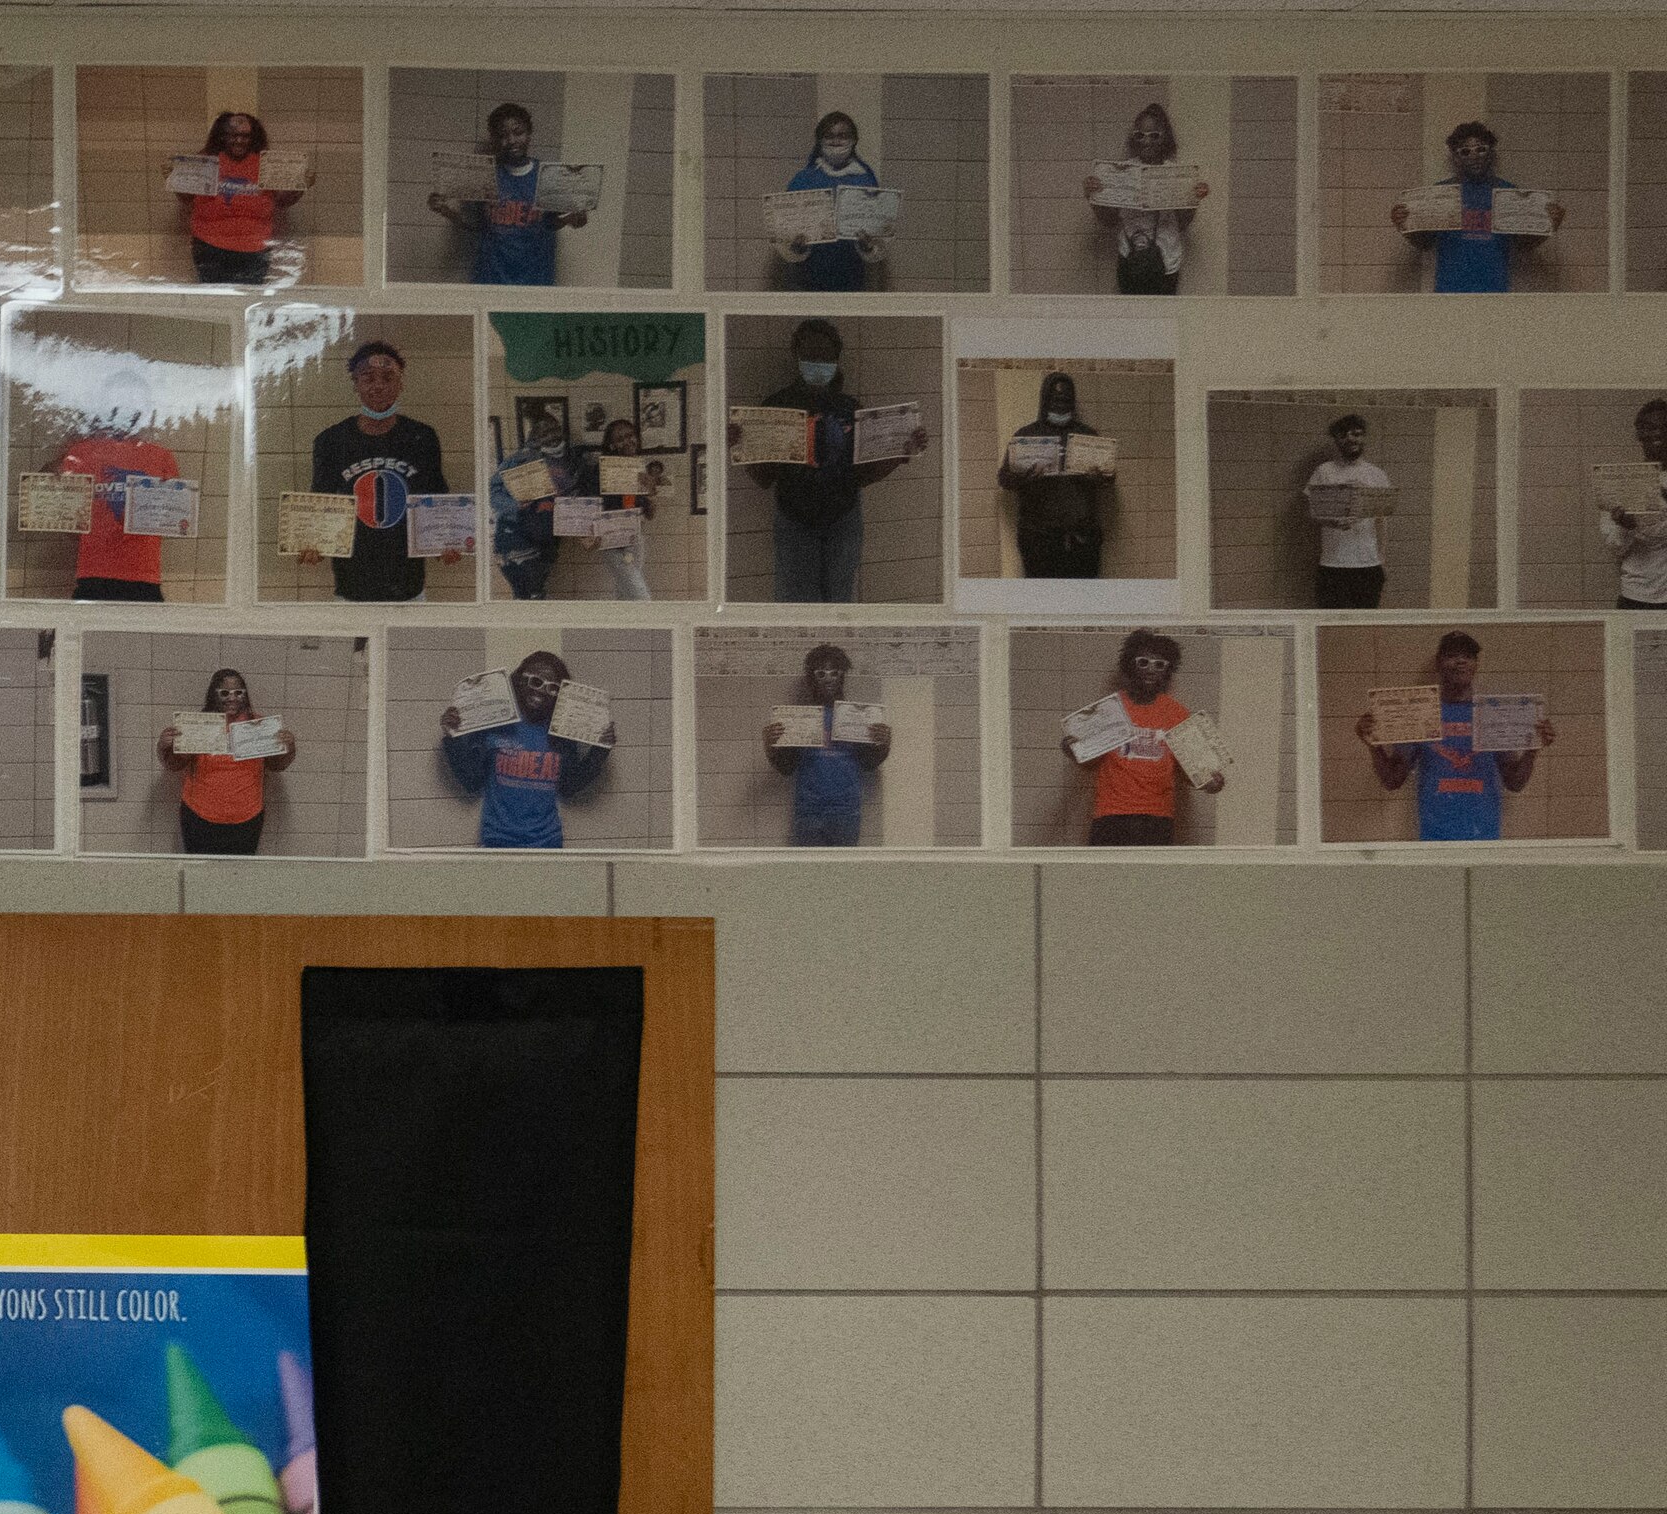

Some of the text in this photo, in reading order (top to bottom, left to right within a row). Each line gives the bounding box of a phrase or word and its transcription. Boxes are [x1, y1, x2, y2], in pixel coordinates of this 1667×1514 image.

[553, 323, 684, 360] HISTORY
[340, 456, 418, 482] RESPECT
[54, 1289, 111, 1322] STILL
[116, 1290, 189, 1324] COLOR.
